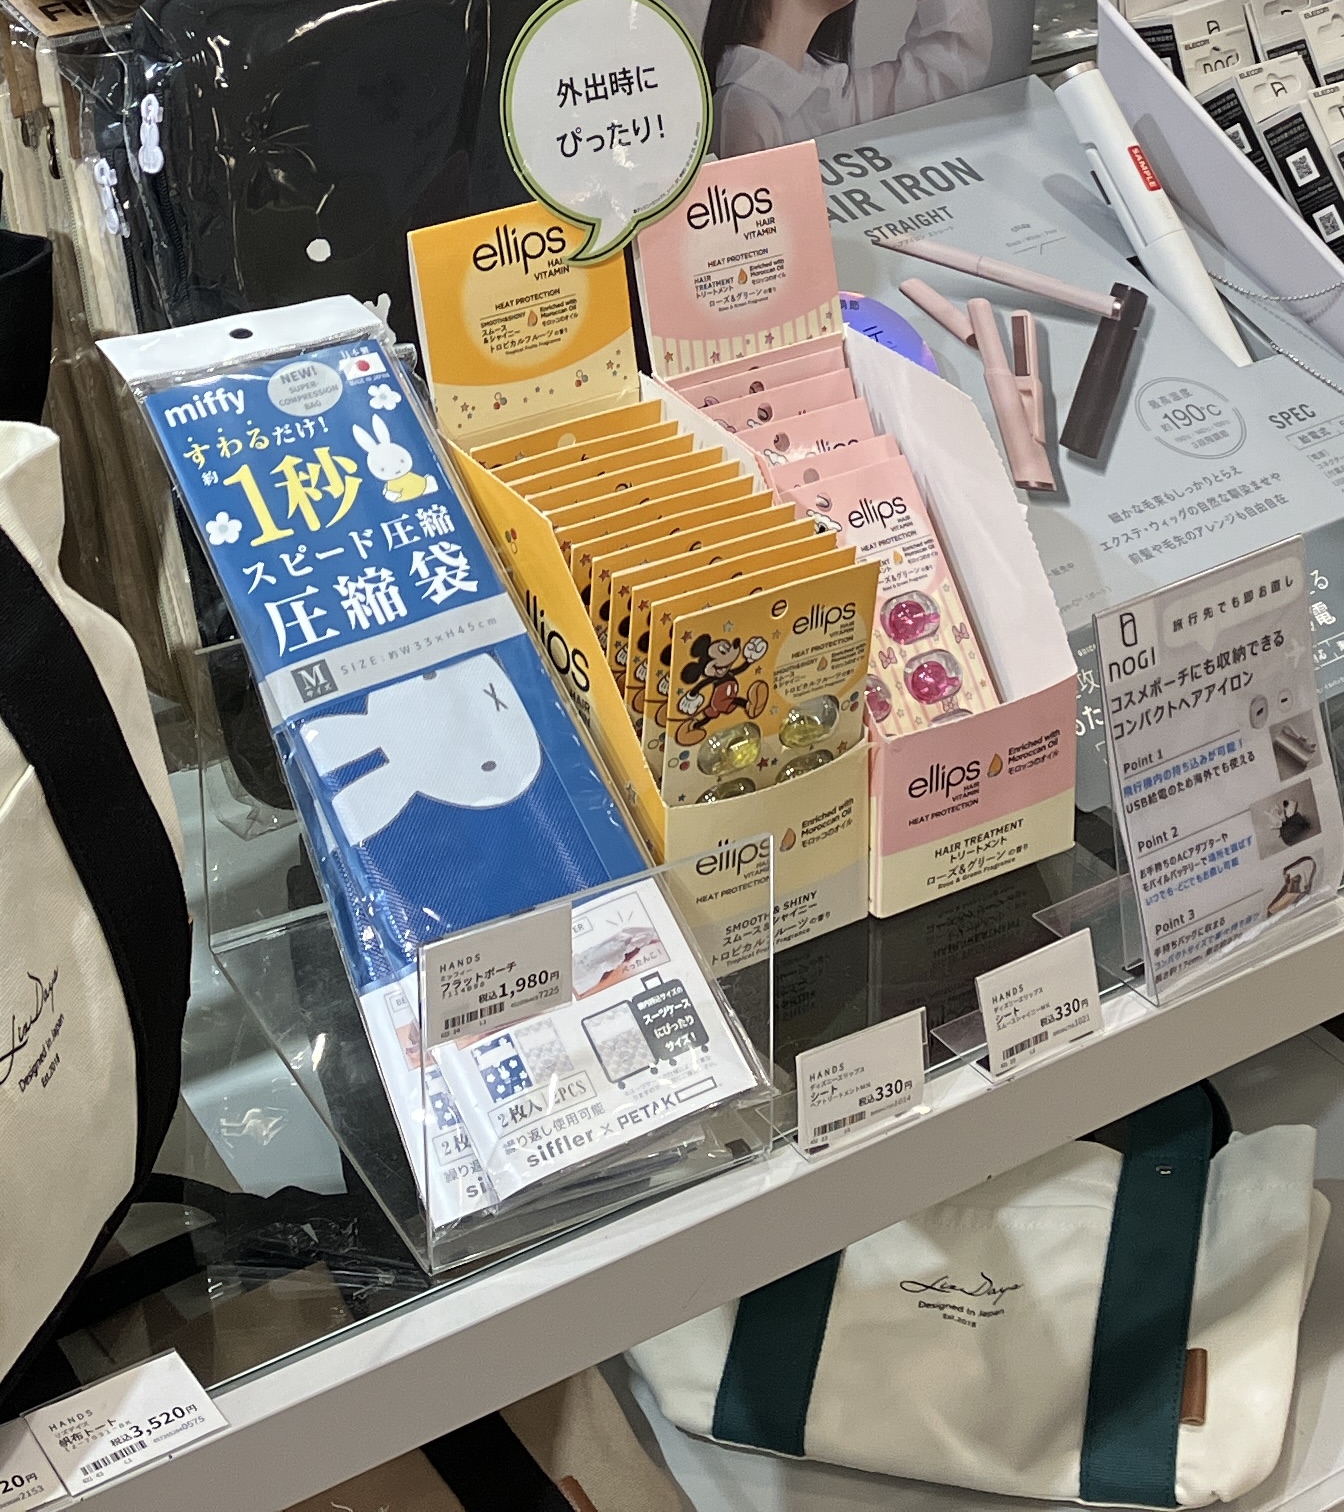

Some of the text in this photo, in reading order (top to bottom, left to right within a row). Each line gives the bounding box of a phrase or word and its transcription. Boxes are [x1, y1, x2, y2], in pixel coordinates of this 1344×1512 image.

[556, 65, 659, 111] 外出時に
[556, 114, 666, 160] ぴったり!
[1130, 145, 1159, 191] SAMPLE
[827, 155, 985, 228] AIR IRON
[686, 184, 773, 235] ellips
[755, 216, 776, 228] HAIR
[863, 205, 955, 247] STRAIGHT
[472, 223, 567, 276] ellips
[743, 225, 777, 241] VITAMIN
[533, 264, 570, 281] VITAMIN
[694, 276, 735, 292] TREATMENT
[494, 287, 561, 311] HEAT PROTECTION
[695, 285, 735, 300] トリートメント
[481, 324, 507, 337] スムース
[279, 364, 318, 385] NEW!
[164, 386, 247, 429] miffy
[278, 384, 340, 407] COMPRESSION
[303, 399, 323, 411] BAG
[1268, 402, 1317, 432] SPEC
[182, 416, 331, 471] すわるだけ!
[222, 446, 365, 548] 1秒
[1107, 465, 1244, 524] 細かな毛束もしっかりとらえ
[847, 495, 907, 530] ellips
[1127, 492, 1291, 567] 前髪や毛先のアレンジも自由自在
[241, 503, 458, 595] スピード圧縮
[263, 541, 480, 659] 圧縮袋
[1171, 574, 1295, 634] 旅行先でも即お直し
[296, 666, 327, 690] M
[1110, 628, 1286, 715] コスメポーチにも収納できる
[1112, 669, 1255, 741] コンパクトヘアアイロン
[1123, 751, 1154, 774] Point
[1125, 750, 1256, 816] USB給電のため海外でも使える
[933, 818, 1024, 860] HAIR TREATMENT
[948, 834, 1008, 863] トリートメント
[1137, 826, 1180, 853] Point 2
[724, 912, 771, 937] SMOOTH
[782, 890, 818, 913] SHINY
[1154, 909, 1196, 936] Point 3
[440, 960, 517, 994] フラットポーチ
[478, 970, 560, 1004] 税込1,980円
[642, 997, 692, 1026] スーツケース
[653, 1014, 696, 1039] にぴったり
[1040, 998, 1089, 1028] 税込330円
[664, 1032, 698, 1053] サイズ!
[811, 1085, 838, 1103] シート
[858, 1079, 913, 1107] 税込330円
[525, 1128, 594, 1168] siffler
[58, 1417, 117, 1448] 帆布トート
[110, 1403, 198, 1448] 税込3,520円
